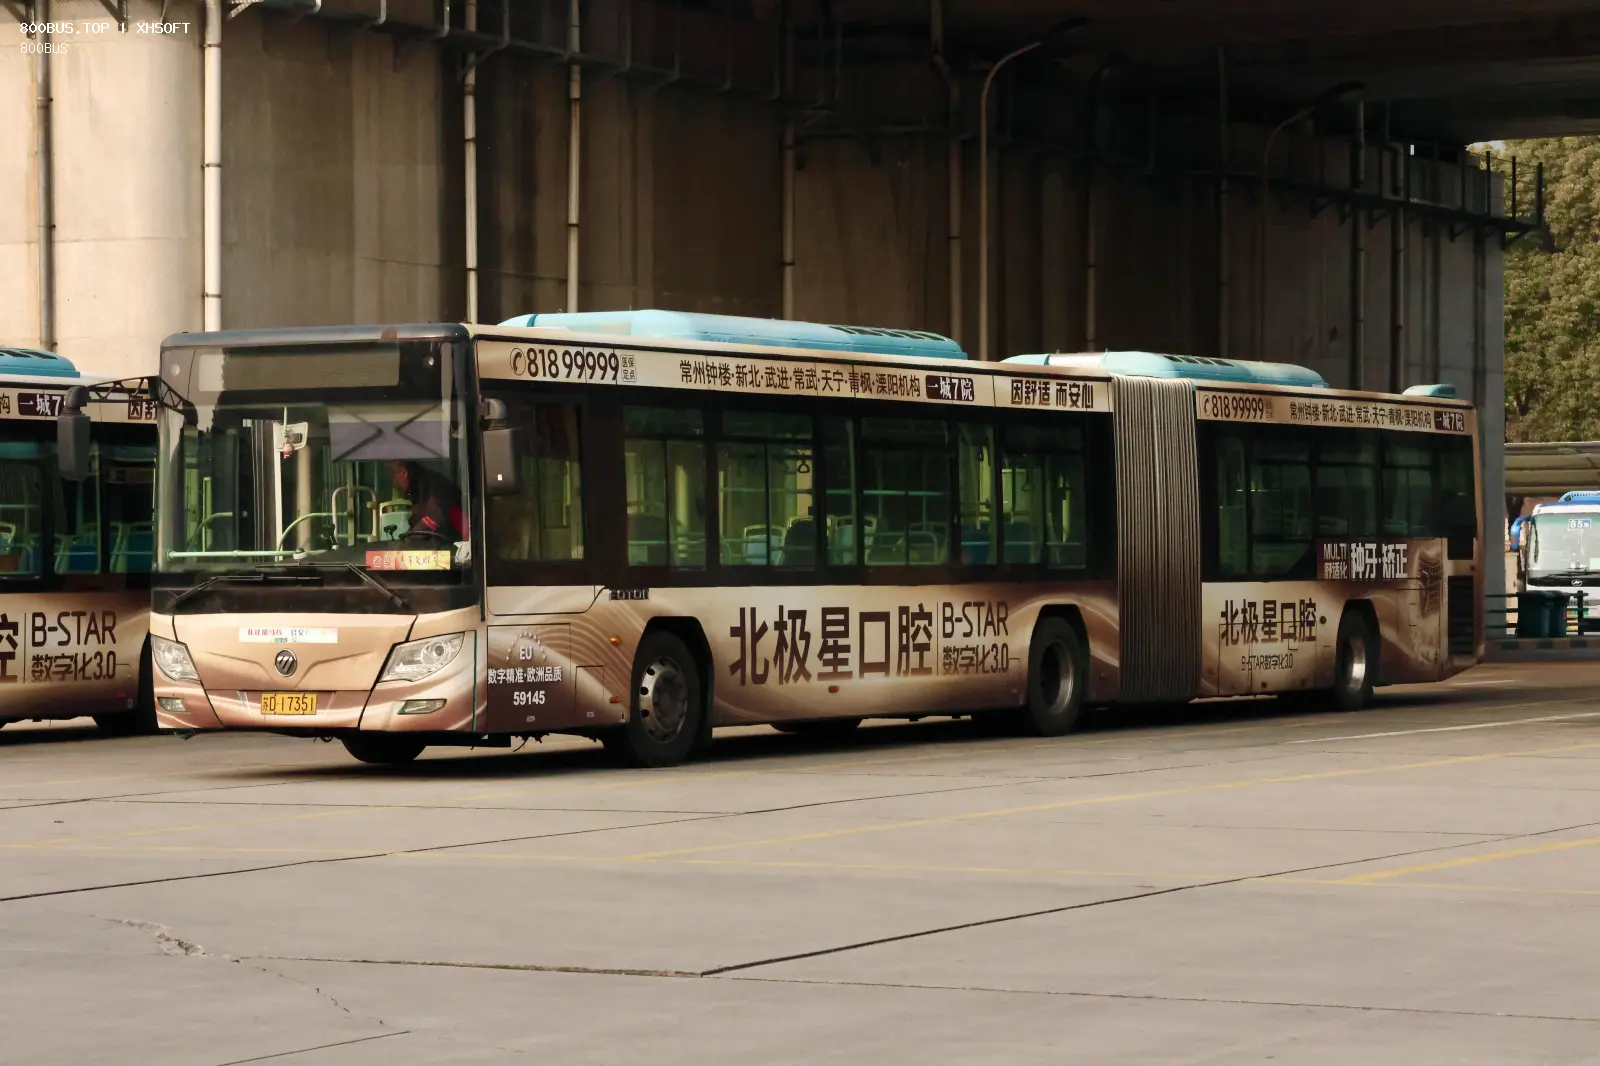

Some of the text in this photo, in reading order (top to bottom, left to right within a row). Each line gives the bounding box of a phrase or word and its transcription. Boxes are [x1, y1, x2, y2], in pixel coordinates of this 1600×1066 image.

[527, 347, 619, 381] 818 99999
[19, 394, 66, 416] 一城7
[1011, 378, 1094, 409] 因舒适 而安心
[1212, 394, 1231, 418] 818
[1232, 396, 1265, 420] 99999
[1351, 542, 1408, 579] 种牙·矫正
[31, 610, 117, 648] B-STAR
[942, 601, 1009, 639] B-STAR
[1220, 597, 1317, 647] 北极星口腔
[519, 646, 533, 660] EU
[729, 603, 933, 686] 北极星口腔
[942, 642, 1009, 676] 数字化3.0
[31, 650, 117, 682] 数字化3.0
[513, 691, 546, 706] 59145
